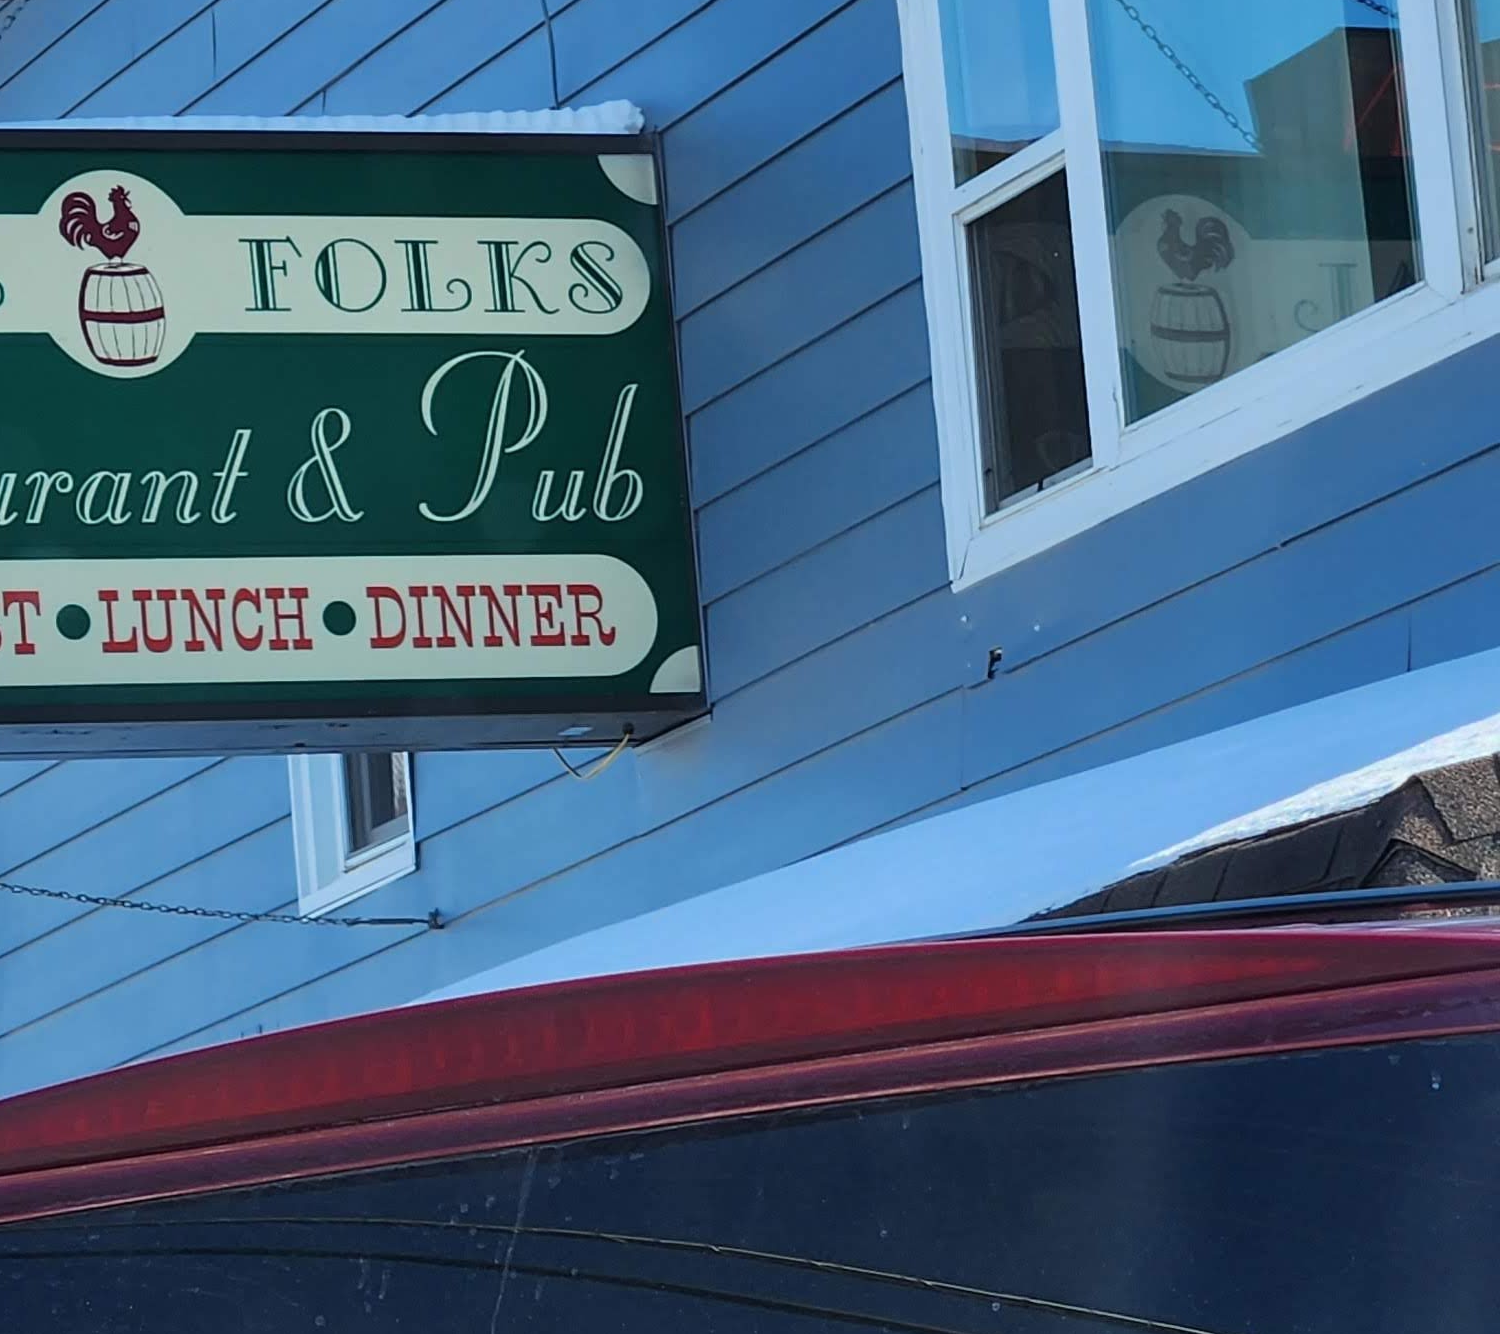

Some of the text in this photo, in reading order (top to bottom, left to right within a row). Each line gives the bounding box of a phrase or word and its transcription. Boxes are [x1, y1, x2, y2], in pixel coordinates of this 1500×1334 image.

[238, 235, 623, 315] FOLKS
[286, 406, 366, 524] &
[417, 349, 645, 524] Pub
[98, 586, 314, 654] LUNCH
[366, 583, 617, 650] DINNER
